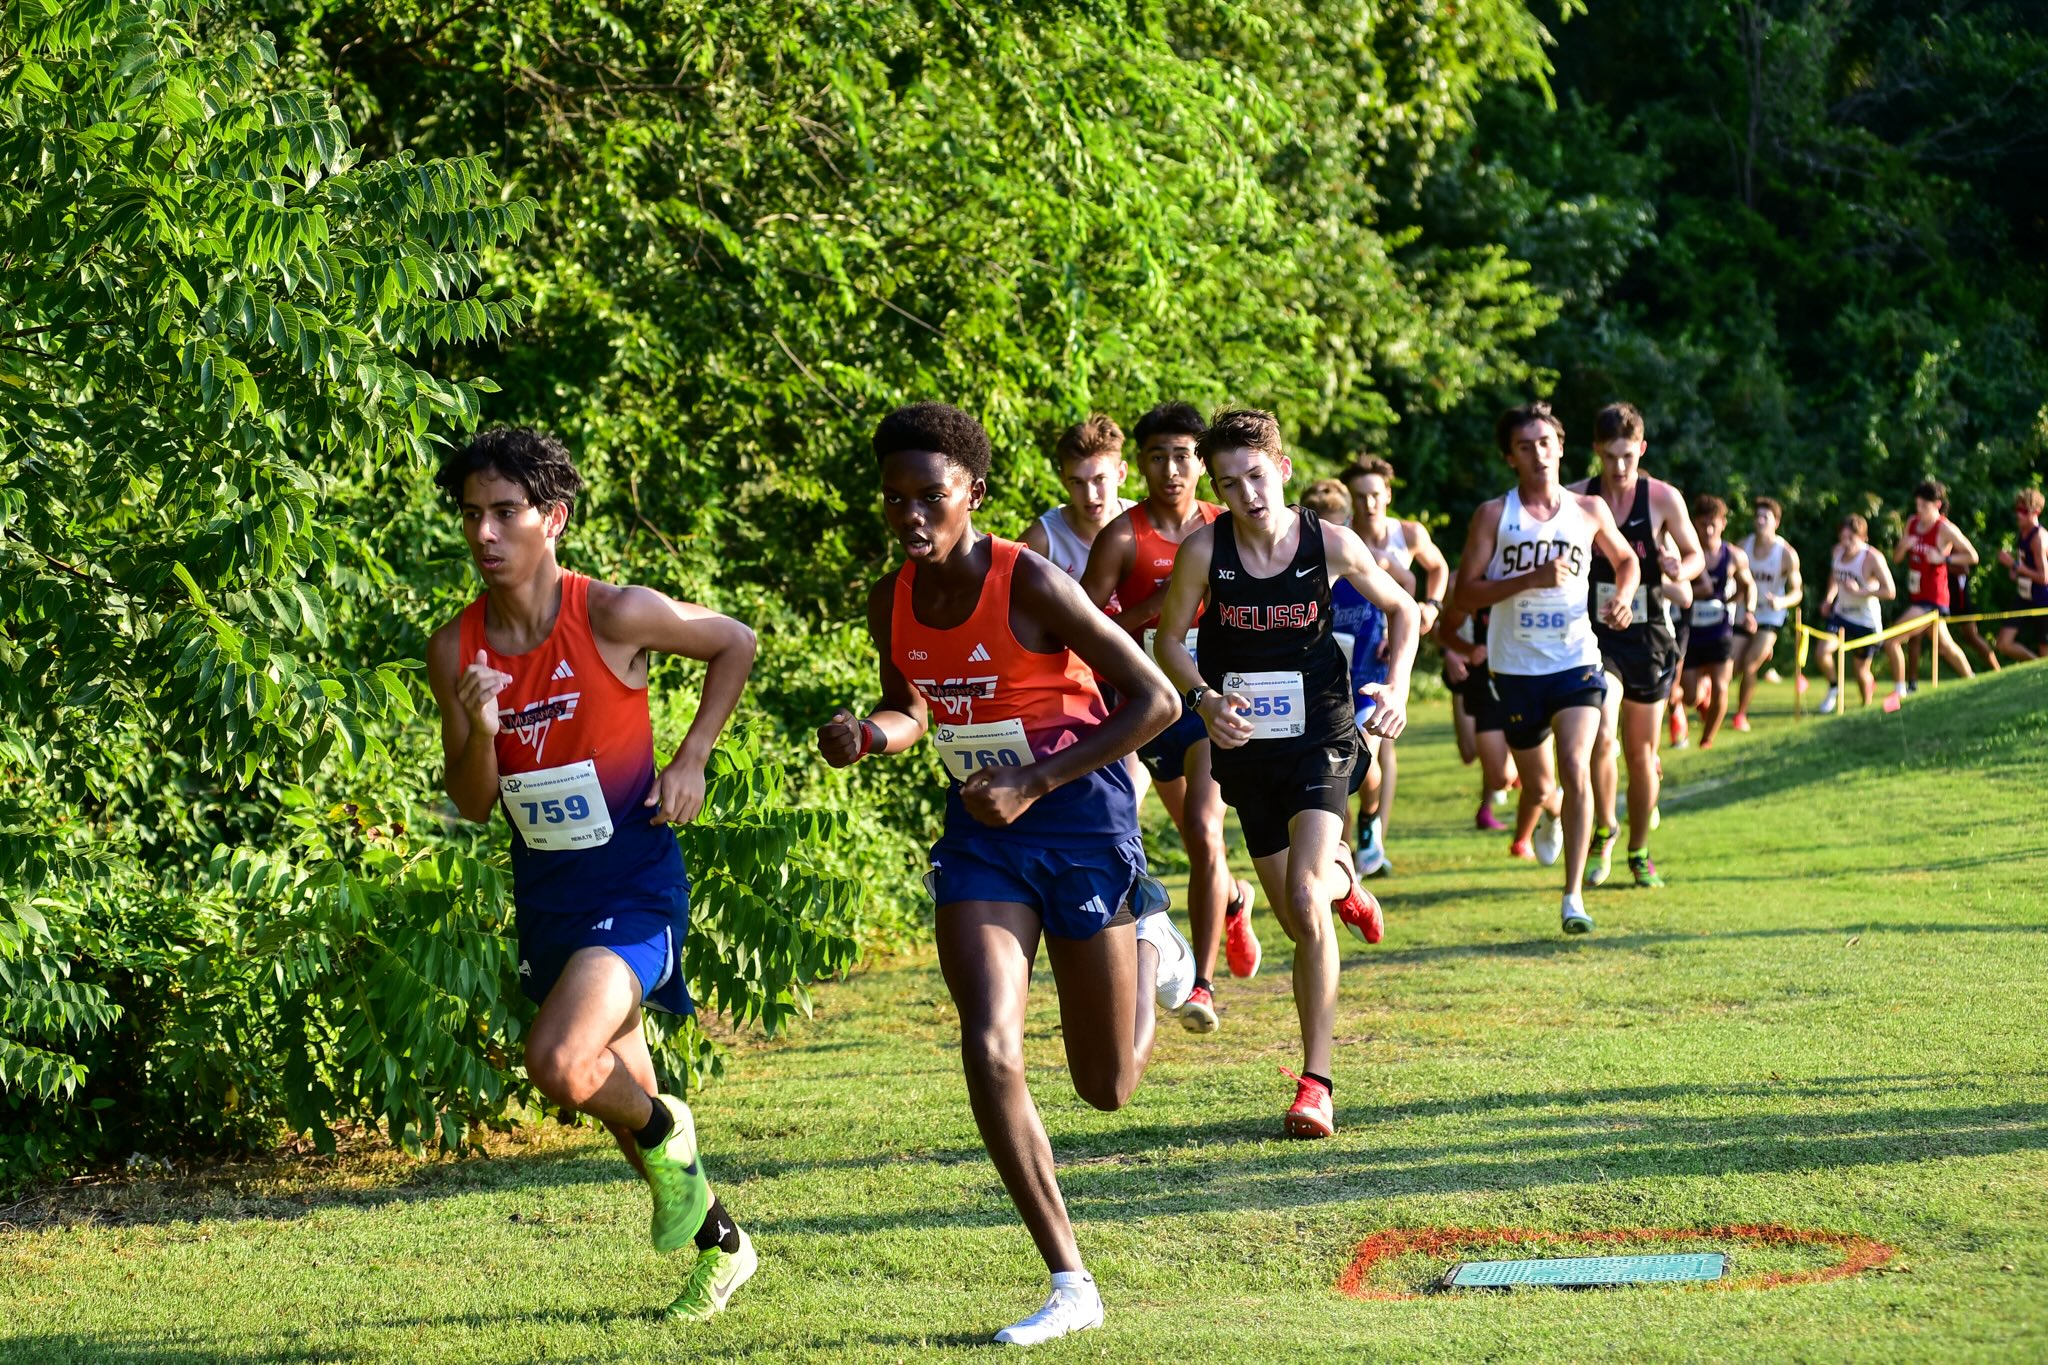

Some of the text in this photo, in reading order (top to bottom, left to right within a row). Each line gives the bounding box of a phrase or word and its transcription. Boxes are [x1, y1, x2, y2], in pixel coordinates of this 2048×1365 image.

[1502, 539, 1583, 577] SCOTS
[1218, 569, 1236, 580] XC
[1219, 600, 1318, 631] MELISSA
[1520, 612, 1565, 629] 536
[508, 703, 562, 728] MUSTANGS
[953, 748, 1021, 770] 760
[520, 795, 590, 825] 759
